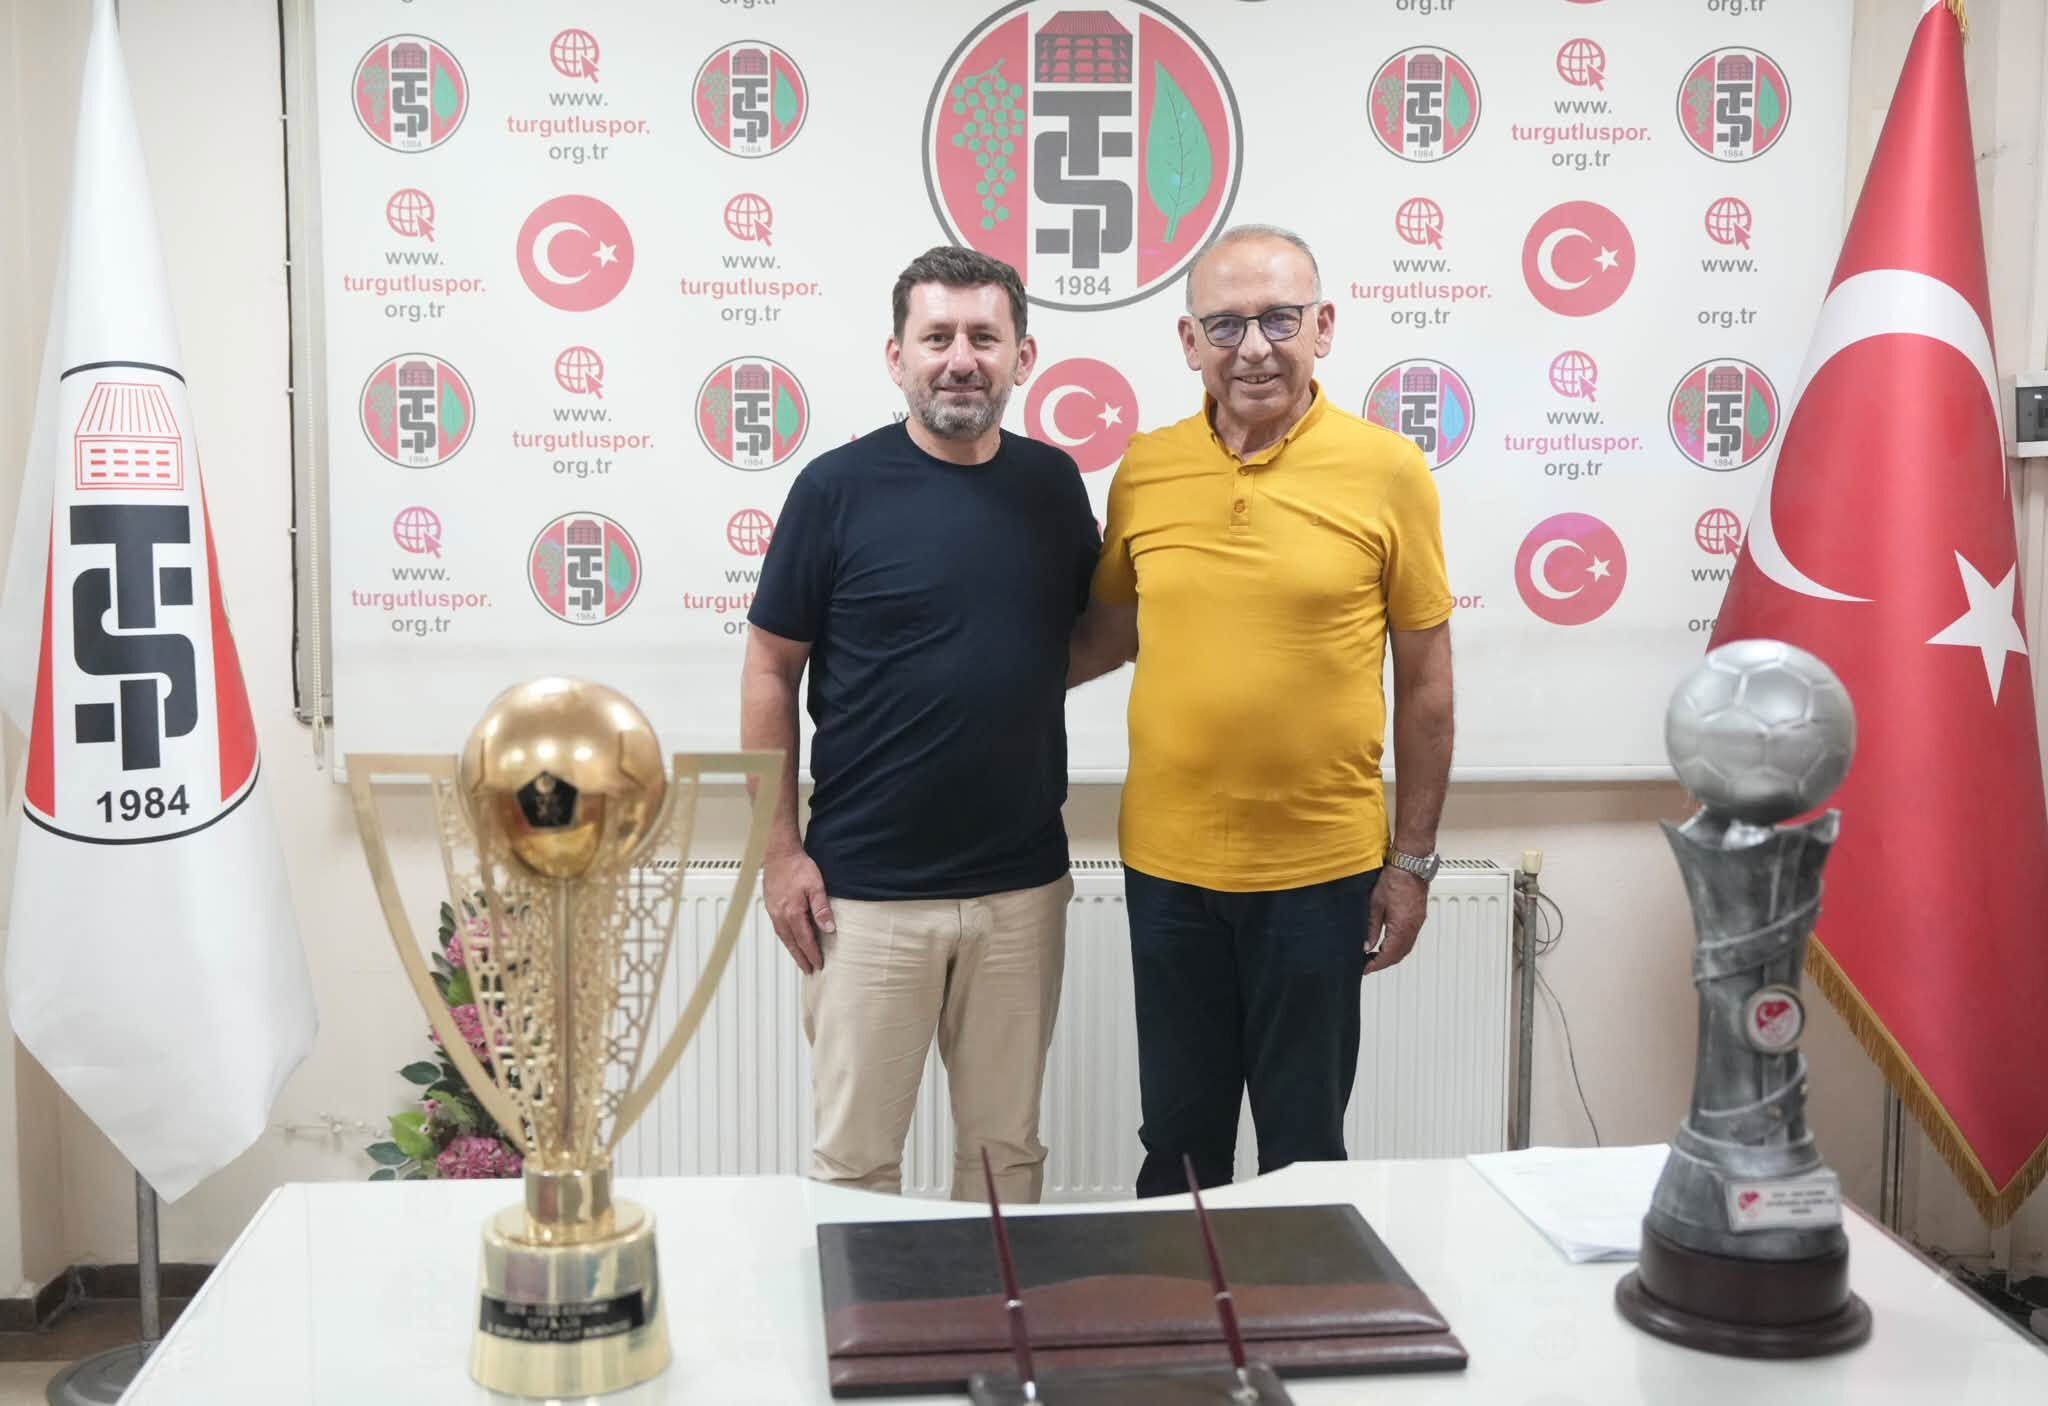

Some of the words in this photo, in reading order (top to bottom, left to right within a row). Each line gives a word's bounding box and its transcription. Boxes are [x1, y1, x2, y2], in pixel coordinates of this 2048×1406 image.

[548, 92, 609, 106] www.
[1553, 100, 1613, 114] www.
[506, 115, 650, 137] turgutluspor.
[1511, 122, 1652, 144] turgutluspor.
[548, 143, 609, 164] org.tr
[1551, 149, 1611, 170] org.tr
[384, 251, 444, 264] www.
[721, 255, 781, 269] www.
[1392, 259, 1451, 272] www.
[1700, 259, 1758, 272] www.
[343, 273, 486, 296] turgutluspor.
[679, 277, 823, 299] turgutluspor.
[1055, 276, 1111, 295] 1984
[1349, 280, 1492, 302] turgutluspor.
[384, 301, 446, 322] org.tr
[720, 304, 782, 326] org.tr
[1390, 307, 1451, 328] org.tr
[1697, 307, 1758, 328] org.tr
[552, 408, 612, 421] www.
[1546, 411, 1605, 424] www.
[512, 430, 655, 452] turgutluspor.
[1503, 432, 1644, 455] turgutluspor.
[552, 457, 613, 478] org.tr
[1543, 459, 1603, 480] org.tr
[391, 567, 451, 581] www.
[351, 589, 492, 611] turgutluspor.
[391, 616, 451, 637] org.tr
[96, 784, 190, 823] 1984
